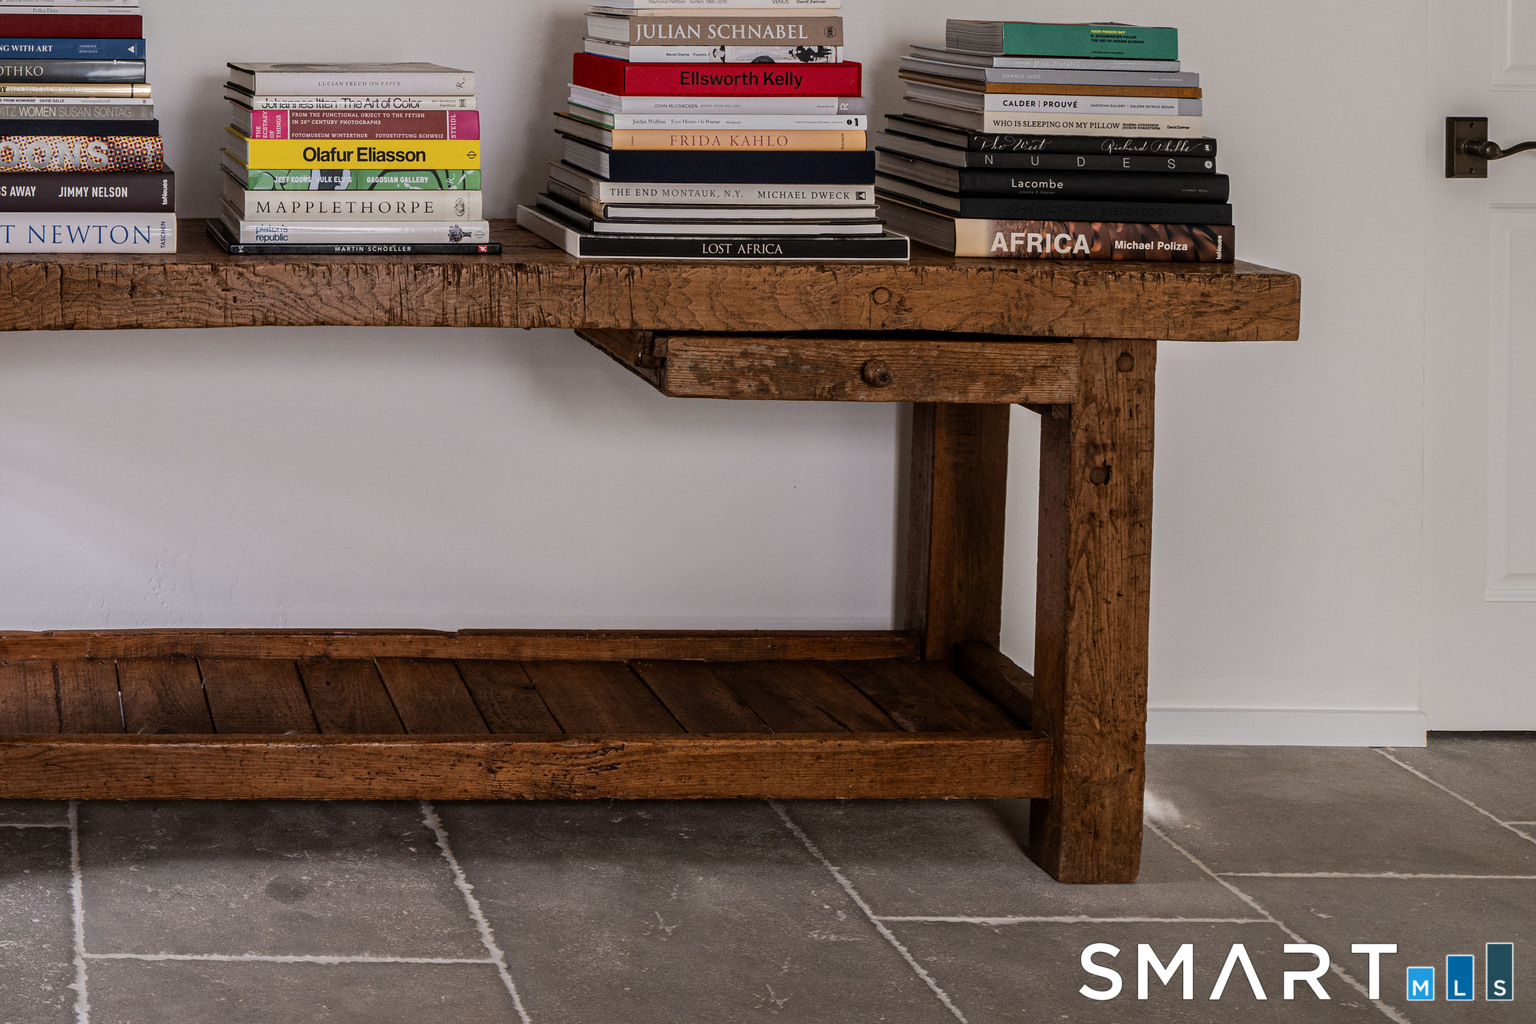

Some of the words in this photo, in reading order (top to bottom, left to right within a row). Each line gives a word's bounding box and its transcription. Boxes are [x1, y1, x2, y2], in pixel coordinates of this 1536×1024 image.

[635, 24, 701, 42] JULIAN
[708, 24, 808, 40] SCHNABEL
[680, 71, 759, 86] Ellsworth
[764, 71, 803, 89] Kelly
[261, 98, 314, 109] Johannes
[315, 98, 338, 109] Itten
[341, 98, 363, 109] The
[364, 98, 379, 109] Art
[381, 98, 391, 109] of
[393, 98, 422, 109] Color
[1043, 100, 1078, 109] PROUVÉ
[18, 106, 56, 117] WOMEN
[58, 107, 91, 117] SUSAN
[94, 107, 132, 118] SONTAG
[1022, 120, 1061, 128] SLEEPING
[269, 130, 275, 138] OF
[670, 135, 721, 146] FRIDA
[730, 135, 789, 147] KAHLO
[1101, 139, 1148, 154] Richard
[303, 147, 354, 162] Olafur
[357, 147, 426, 162] Eliasson
[1011, 178, 1064, 189] Lacombe
[9, 186, 37, 197] AWAY
[58, 186, 90, 197] JIMMY
[92, 186, 128, 198] NELSON
[609, 188, 631, 196] THE
[662, 189, 720, 198] MONTAUK,
[724, 190, 744, 198] N.Y.
[757, 190, 807, 199] MICHAEL
[811, 191, 850, 200] DWECK
[256, 201, 434, 214] MAPPLETHORPE
[1100, 207, 1139, 216] SKETCH
[1143, 207, 1170, 216] BOOK
[27, 225, 152, 244] NEWTON
[256, 233, 289, 243] republic
[702, 243, 733, 254] LOST
[737, 243, 783, 255] AFRICA
[990, 232, 1091, 254] AFRICA
[1114, 240, 1154, 250] Michael
[1157, 241, 1188, 251] Poliza
